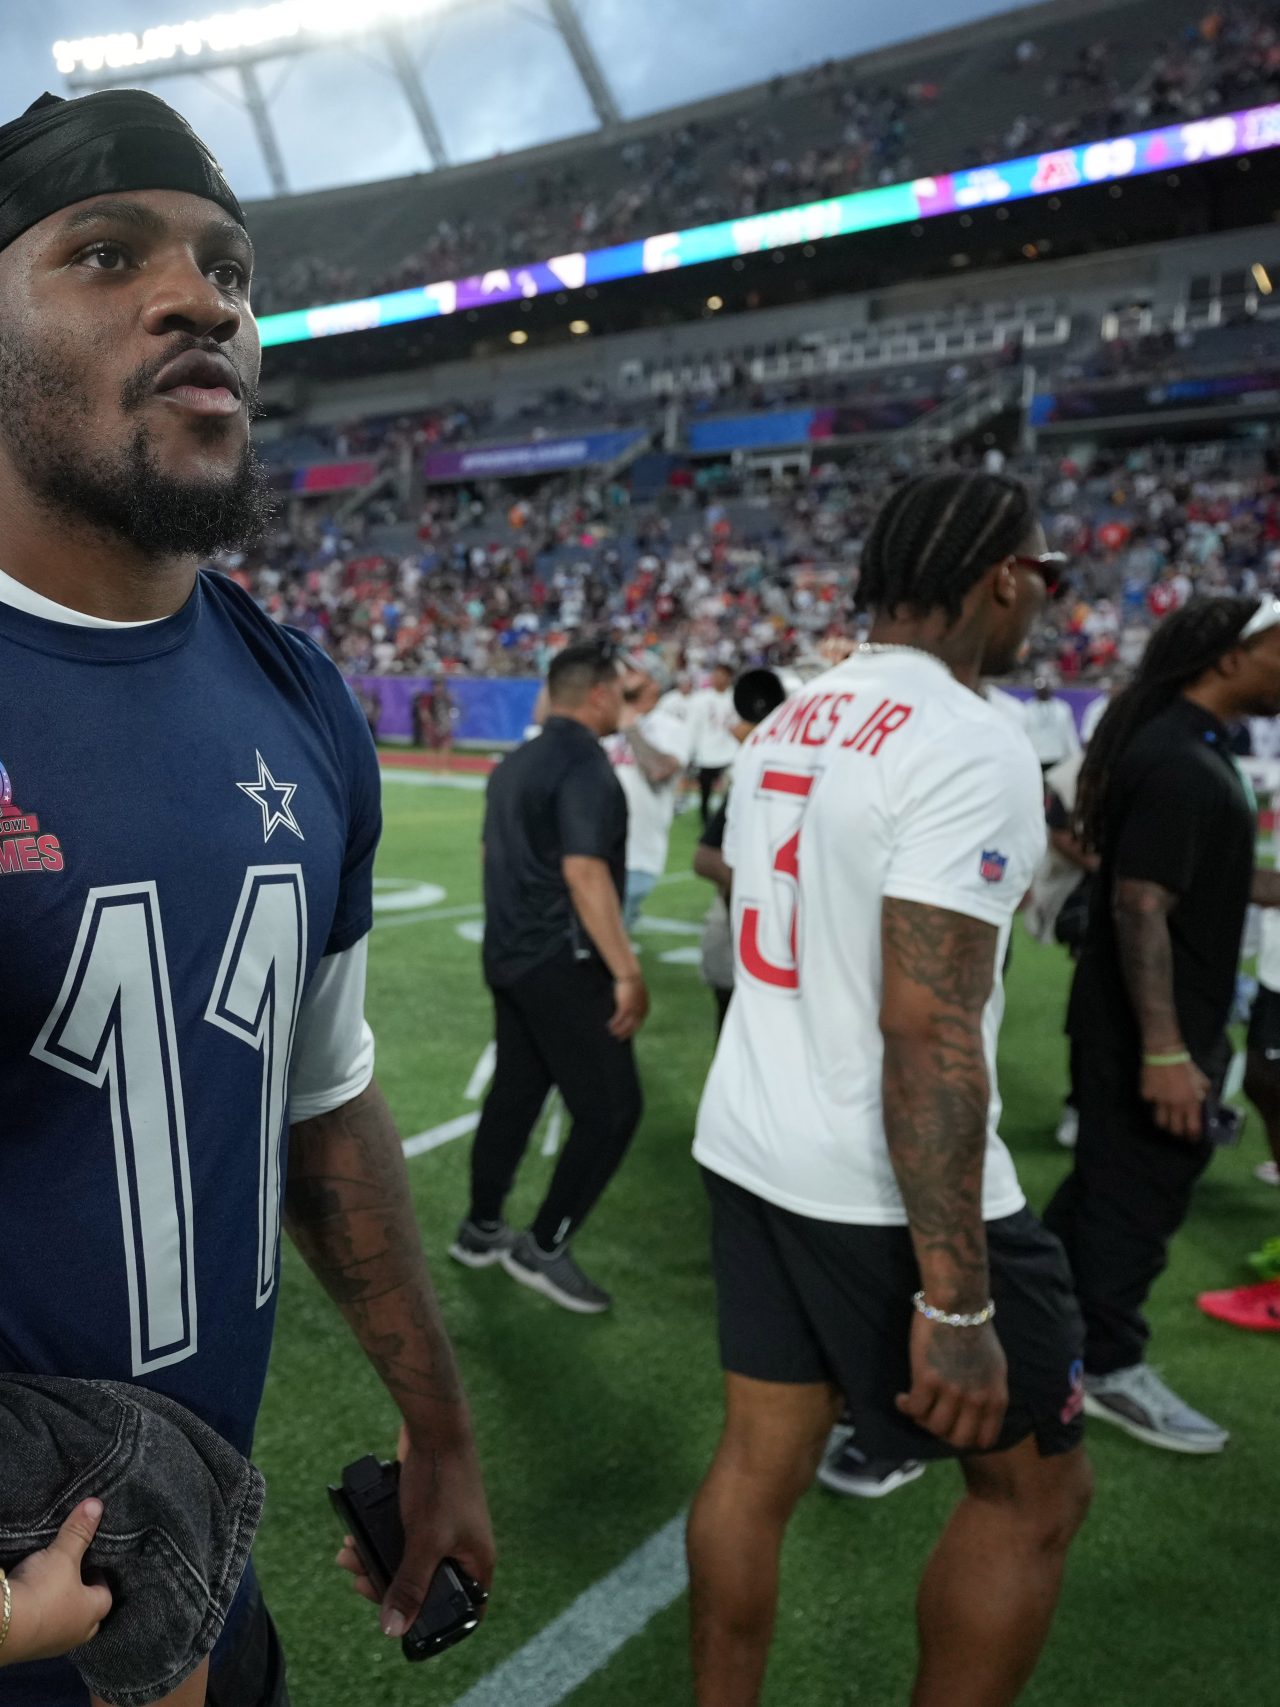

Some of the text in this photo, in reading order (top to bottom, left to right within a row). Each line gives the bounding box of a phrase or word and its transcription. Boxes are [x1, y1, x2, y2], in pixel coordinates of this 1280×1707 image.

[840, 698, 913, 757] JR
[736, 766, 816, 994] 3
[30, 863, 308, 1377] 11
